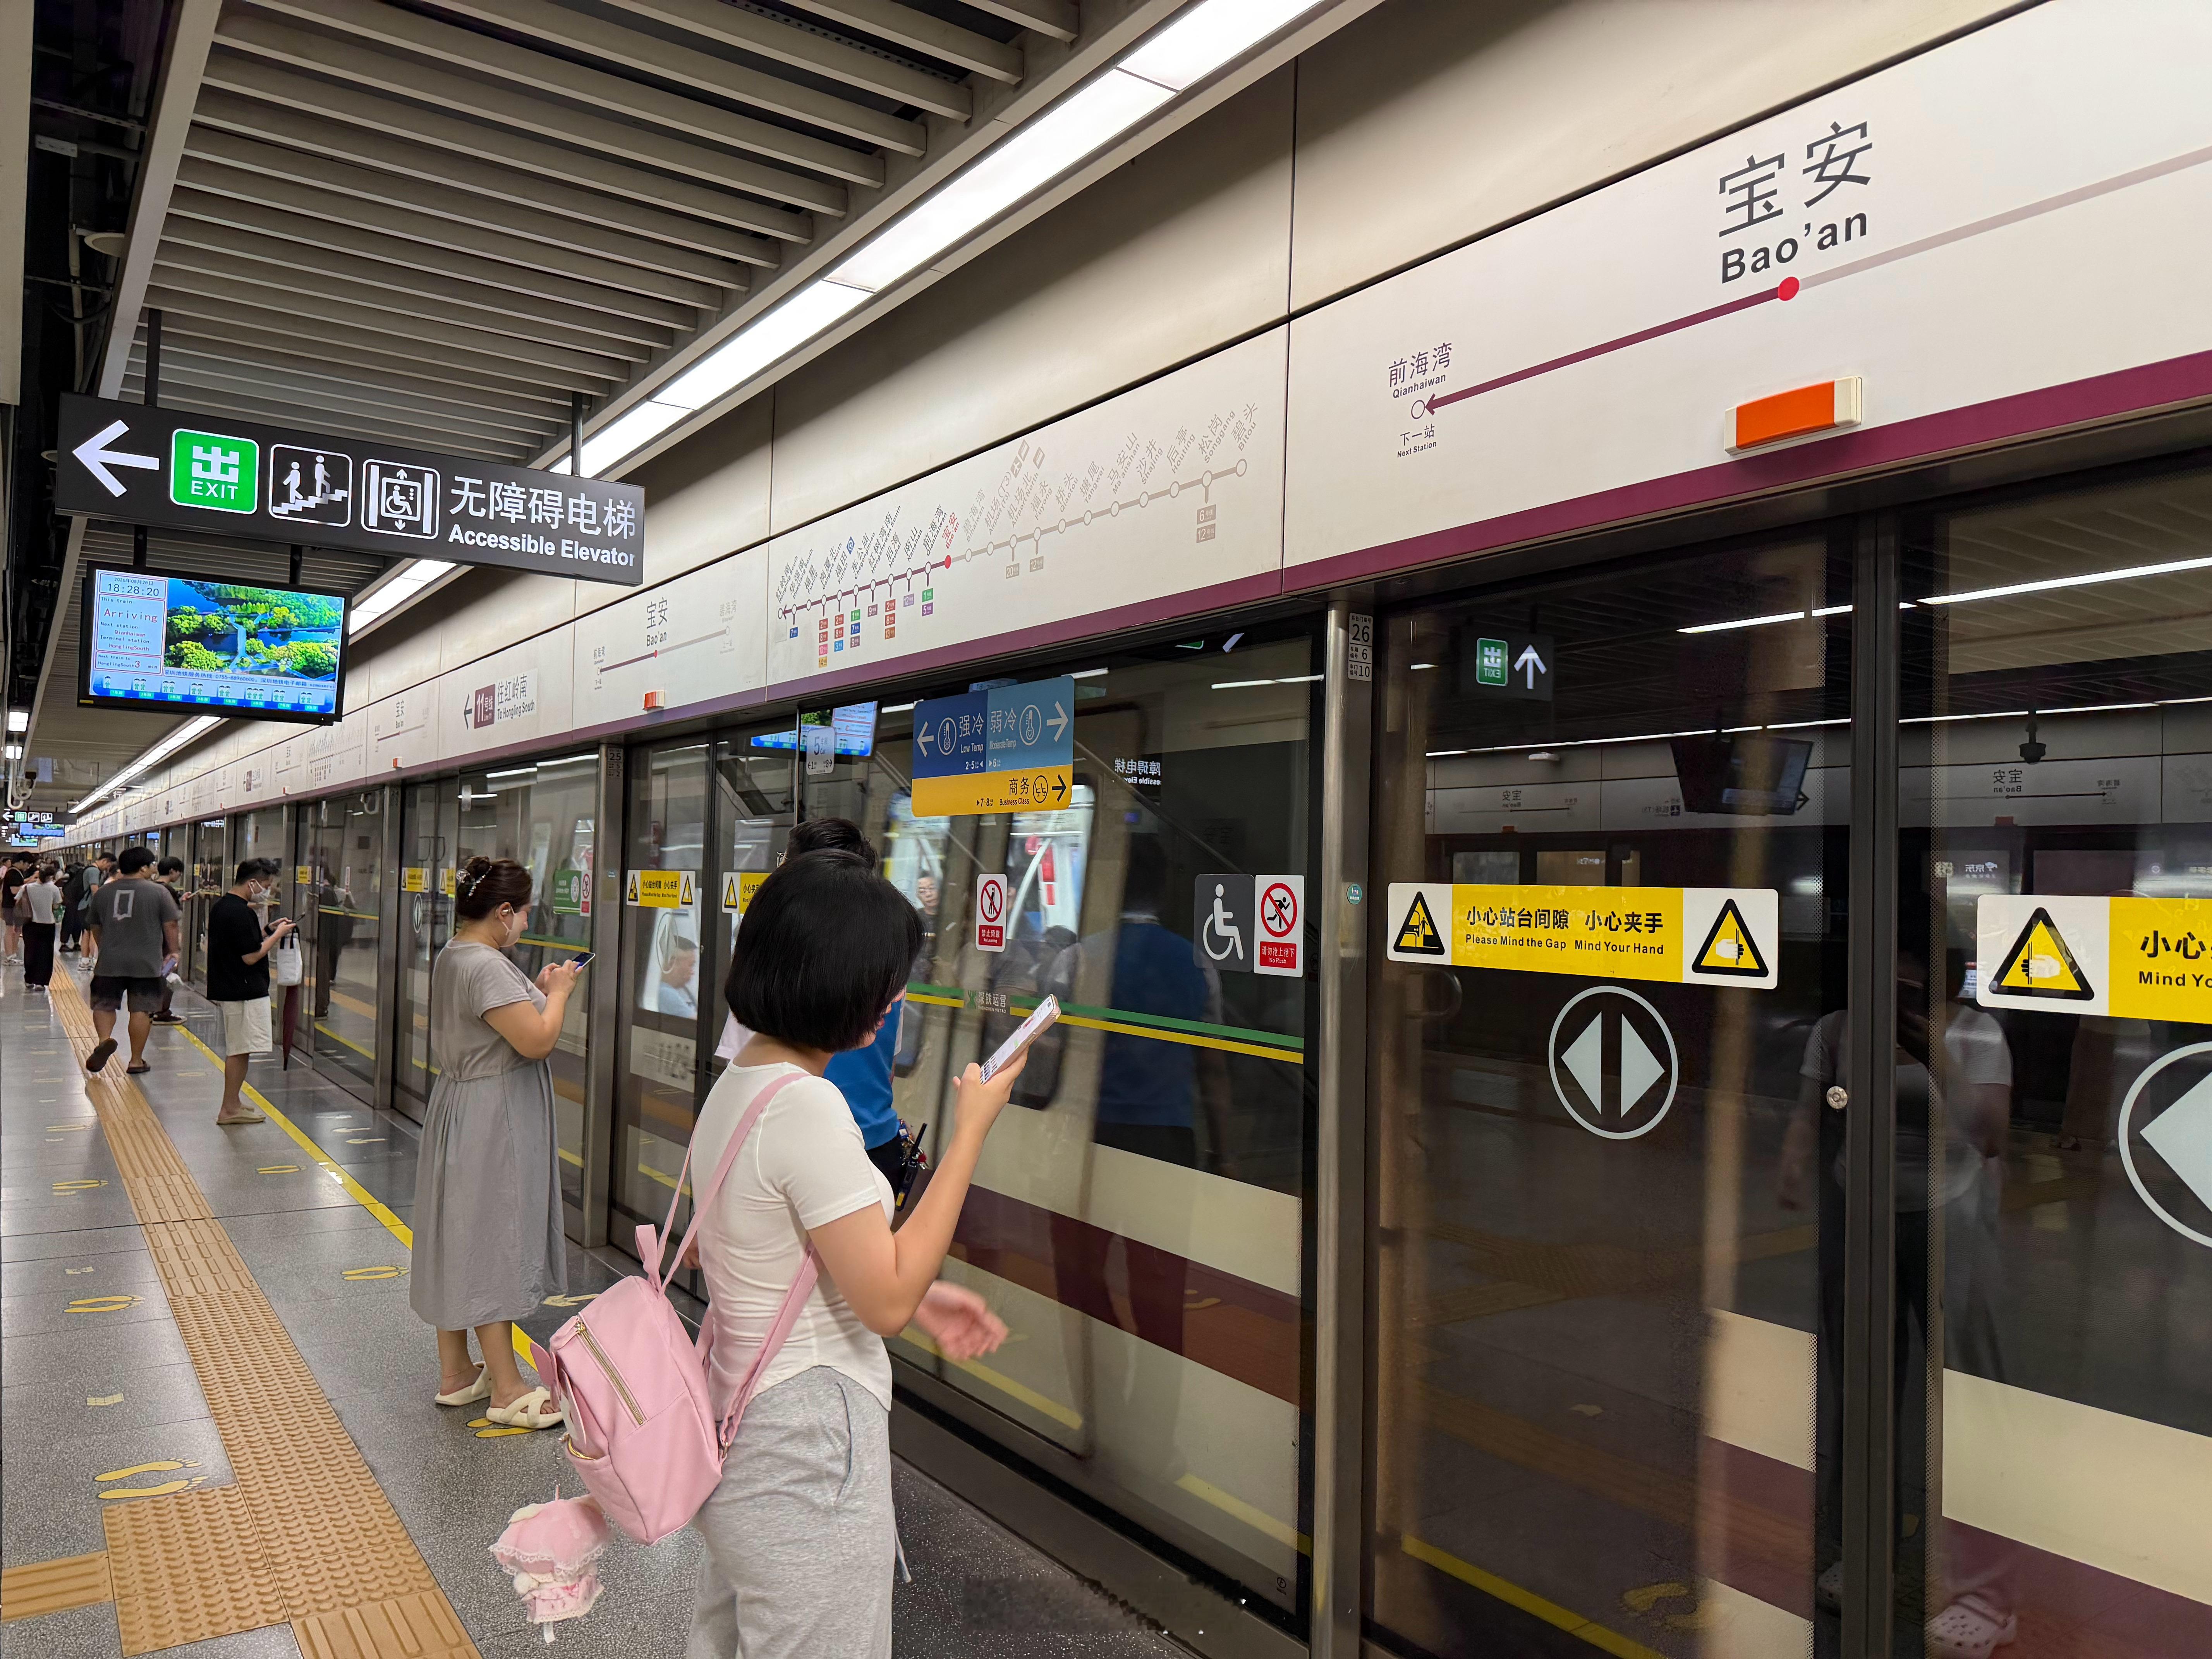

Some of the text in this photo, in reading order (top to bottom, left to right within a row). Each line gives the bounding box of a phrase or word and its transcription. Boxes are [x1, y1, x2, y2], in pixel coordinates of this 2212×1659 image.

[1719, 121, 1873, 237] 宝安
[1722, 212, 1867, 284] Bao'an
[1389, 342, 1452, 387] 前海湾
[1393, 374, 1446, 398] Qianhaiwan
[1198, 414, 1222, 454] 松岗
[1204, 410, 1235, 463] Songgang
[1231, 402, 1258, 443] 碧头
[1238, 422, 1256, 451] Bitou
[1400, 424, 1435, 446] 下一站
[1108, 433, 1137, 485] 马安山
[1136, 439, 1156, 477] 沙井
[1166, 426, 1187, 466] 后亭
[1172, 434, 1195, 474] Houting
[1397, 441, 1437, 458] Next Station
[1080, 460, 1099, 497] 塘尾
[1113, 443, 1140, 494] Ma'anshan
[1142, 448, 1163, 484] Shajing
[191, 480, 238, 500] EXIT
[1007, 472, 1032, 520] 机场北
[1012, 473, 1039, 528] Airport North
[1031, 481, 1048, 512] 福永
[1035, 488, 1052, 520] Fuyong
[1056, 473, 1074, 505] 桥头
[1060, 477, 1078, 512] Qiaotou
[449, 476, 635, 539] 无障碍电梯
[989, 508, 1002, 535] Airport
[904, 527, 918, 556] 南山
[923, 504, 943, 550] 前海湾
[942, 512, 957, 543] 宝安
[448, 524, 635, 567] Accessible Elevator
[886, 532, 901, 562] 后海
[108, 584, 159, 596] 18:28:20
[104, 608, 157, 623] Arriving
[646, 597, 668, 629] 宝安
[646, 631, 667, 647] Bao'an
[1352, 623, 1370, 642] 26
[1362, 649, 1367, 660] 6
[1359, 666, 1370, 677] 10
[497, 674, 527, 706] 往红岭南
[497, 699, 535, 720] To Hongling South
[990, 707, 1017, 733] 弱冷
[959, 713, 984, 738] 强冷
[814, 736, 819, 755] 5
[961, 743, 983, 753] Low Temp
[1006, 738, 1017, 749] Temp
[1009, 777, 1029, 795] 商务
[1467, 906, 1663, 933] 小心站台间隙 小心夹手
[1466, 934, 1663, 954] Please Mind the Gap Mind Your Hand
[2140, 930, 2212, 960] 小心
[2139, 971, 2185, 986] Mind
[978, 992, 1006, 1007] 深铁运营
